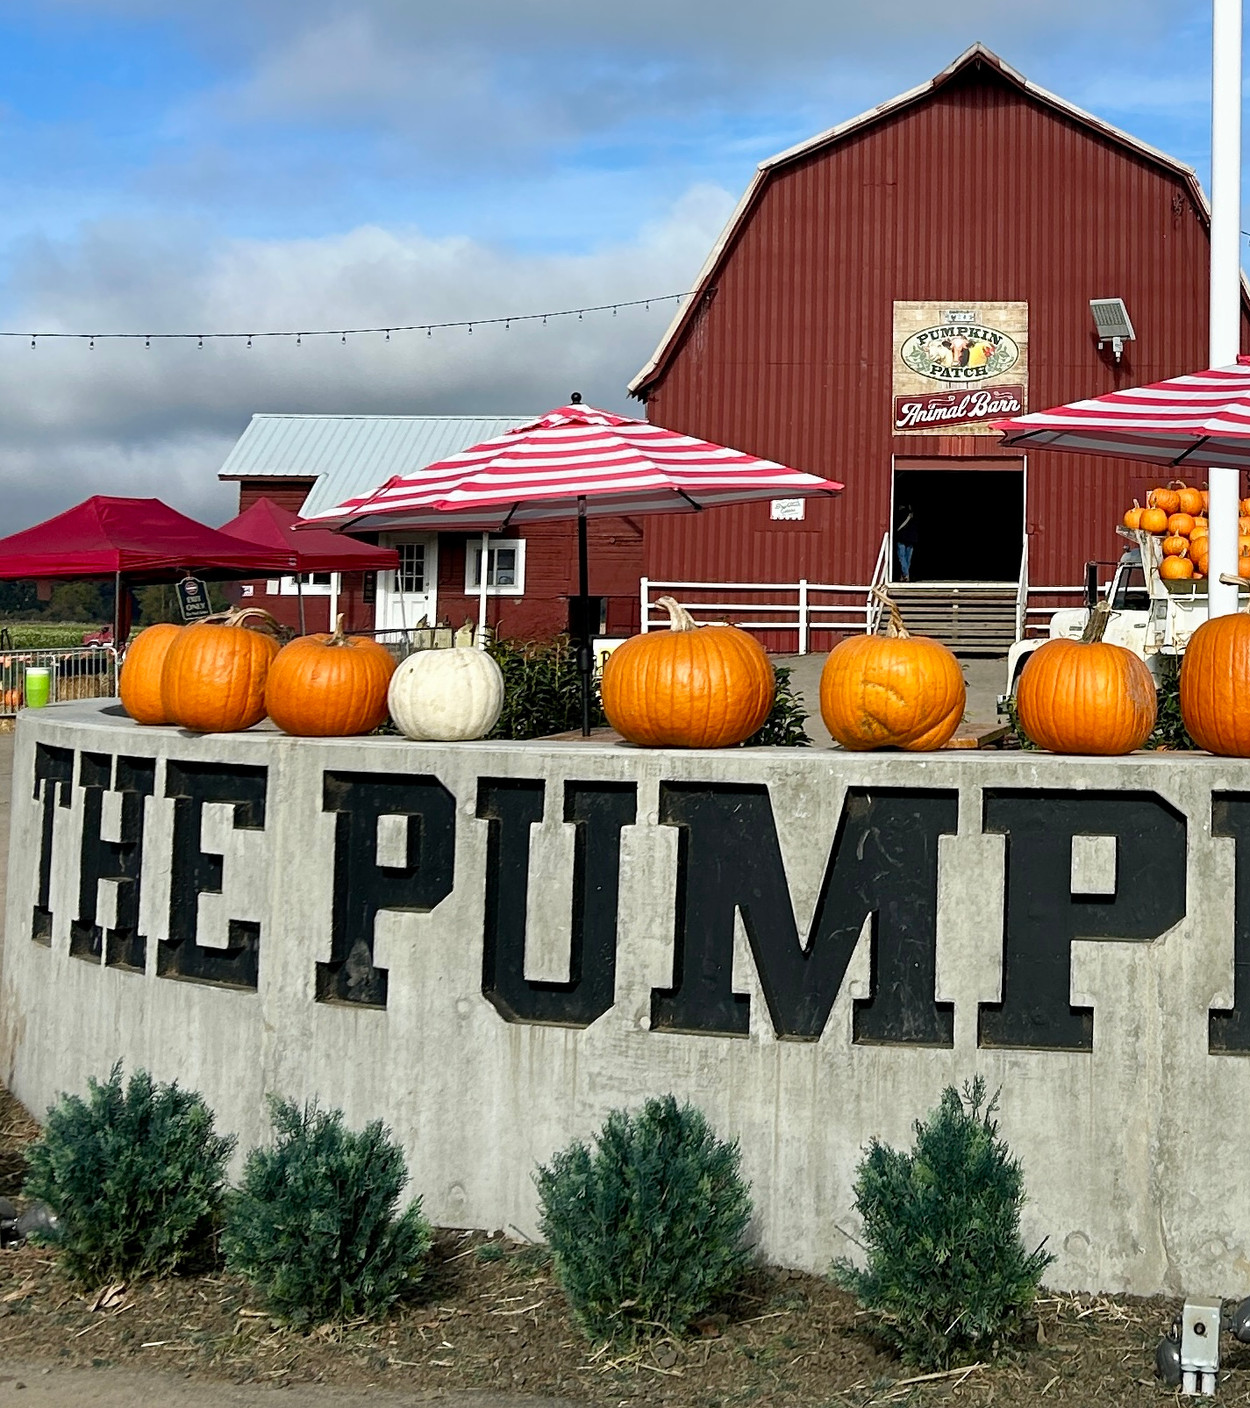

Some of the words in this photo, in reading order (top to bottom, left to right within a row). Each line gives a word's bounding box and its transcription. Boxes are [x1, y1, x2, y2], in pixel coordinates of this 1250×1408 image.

[917, 326, 1003, 345] PUMPKIN
[929, 364, 988, 378] PATCH
[896, 393, 970, 428] Animal
[968, 390, 1021, 418] Barn
[32, 741, 269, 993] THE
